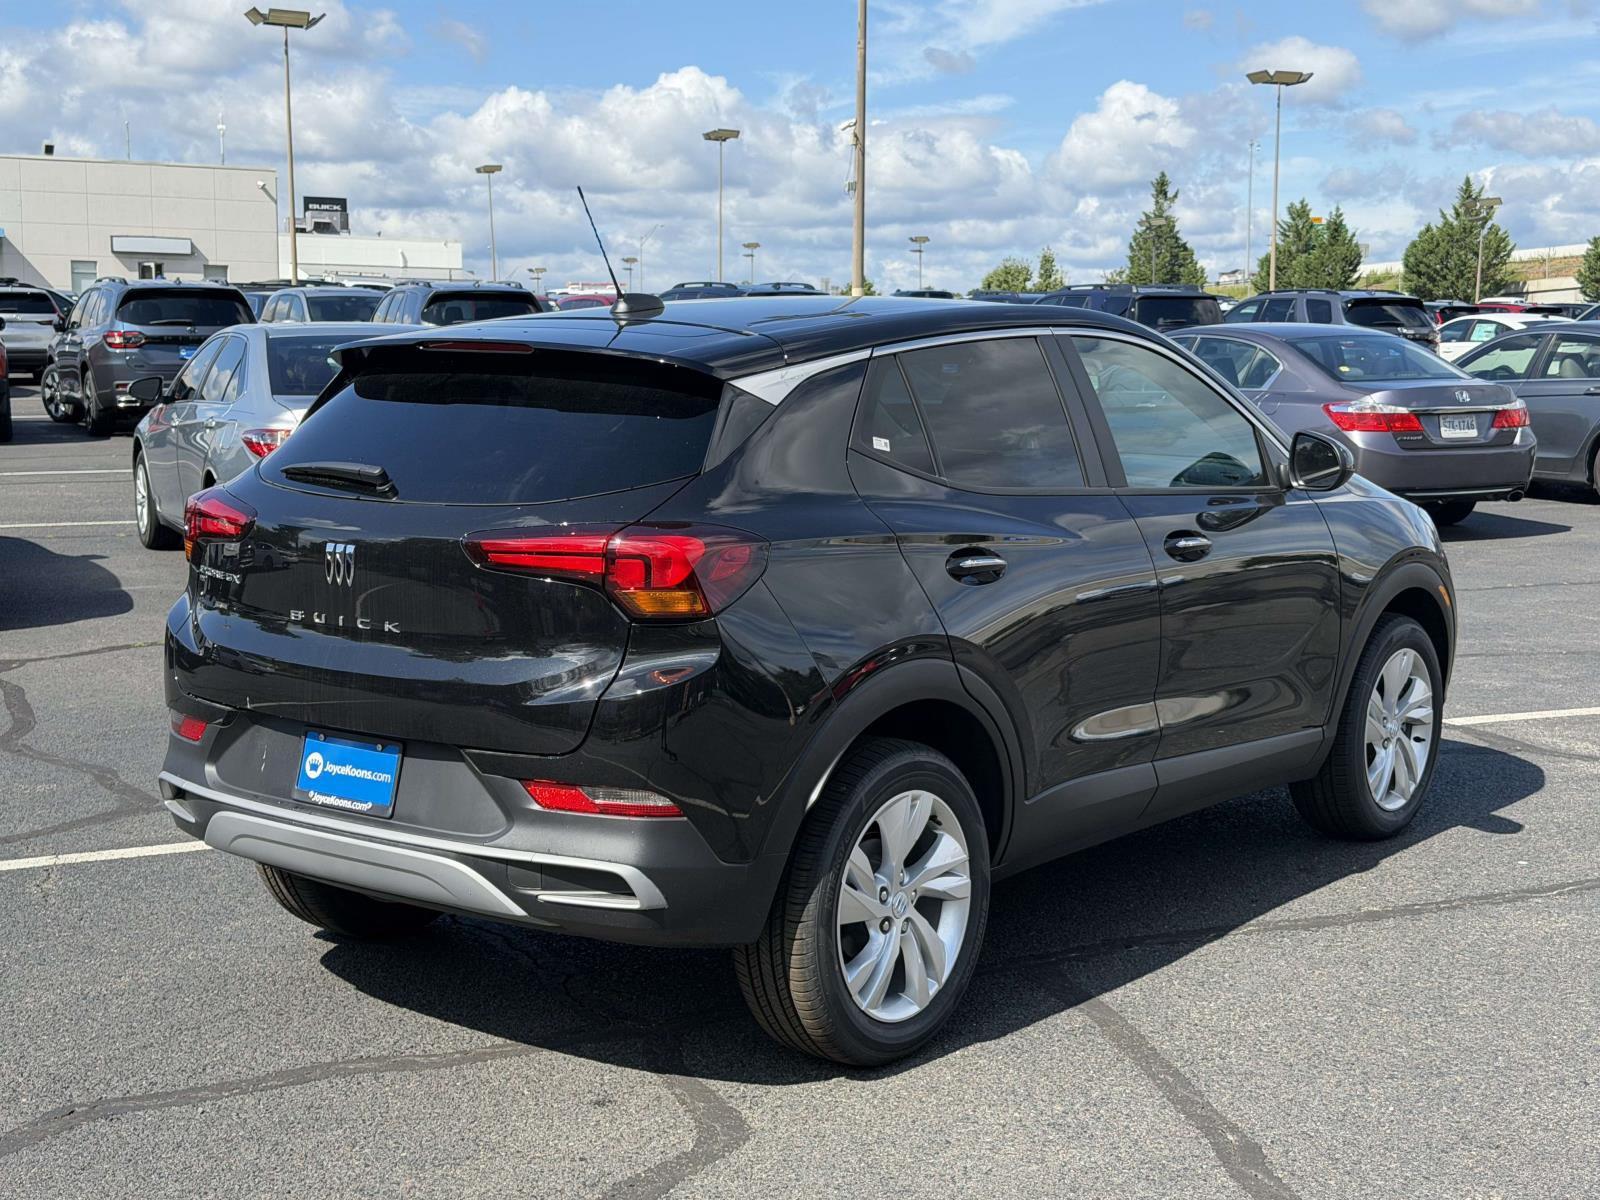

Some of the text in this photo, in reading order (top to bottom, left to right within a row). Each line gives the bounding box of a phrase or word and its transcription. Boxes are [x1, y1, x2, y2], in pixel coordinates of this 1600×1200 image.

[308, 203, 342, 211] BUICK
[289, 609, 401, 634] BUICK
[324, 761, 391, 783] JoyceKoons.com
[311, 791, 368, 812] JoyceKoons.com
